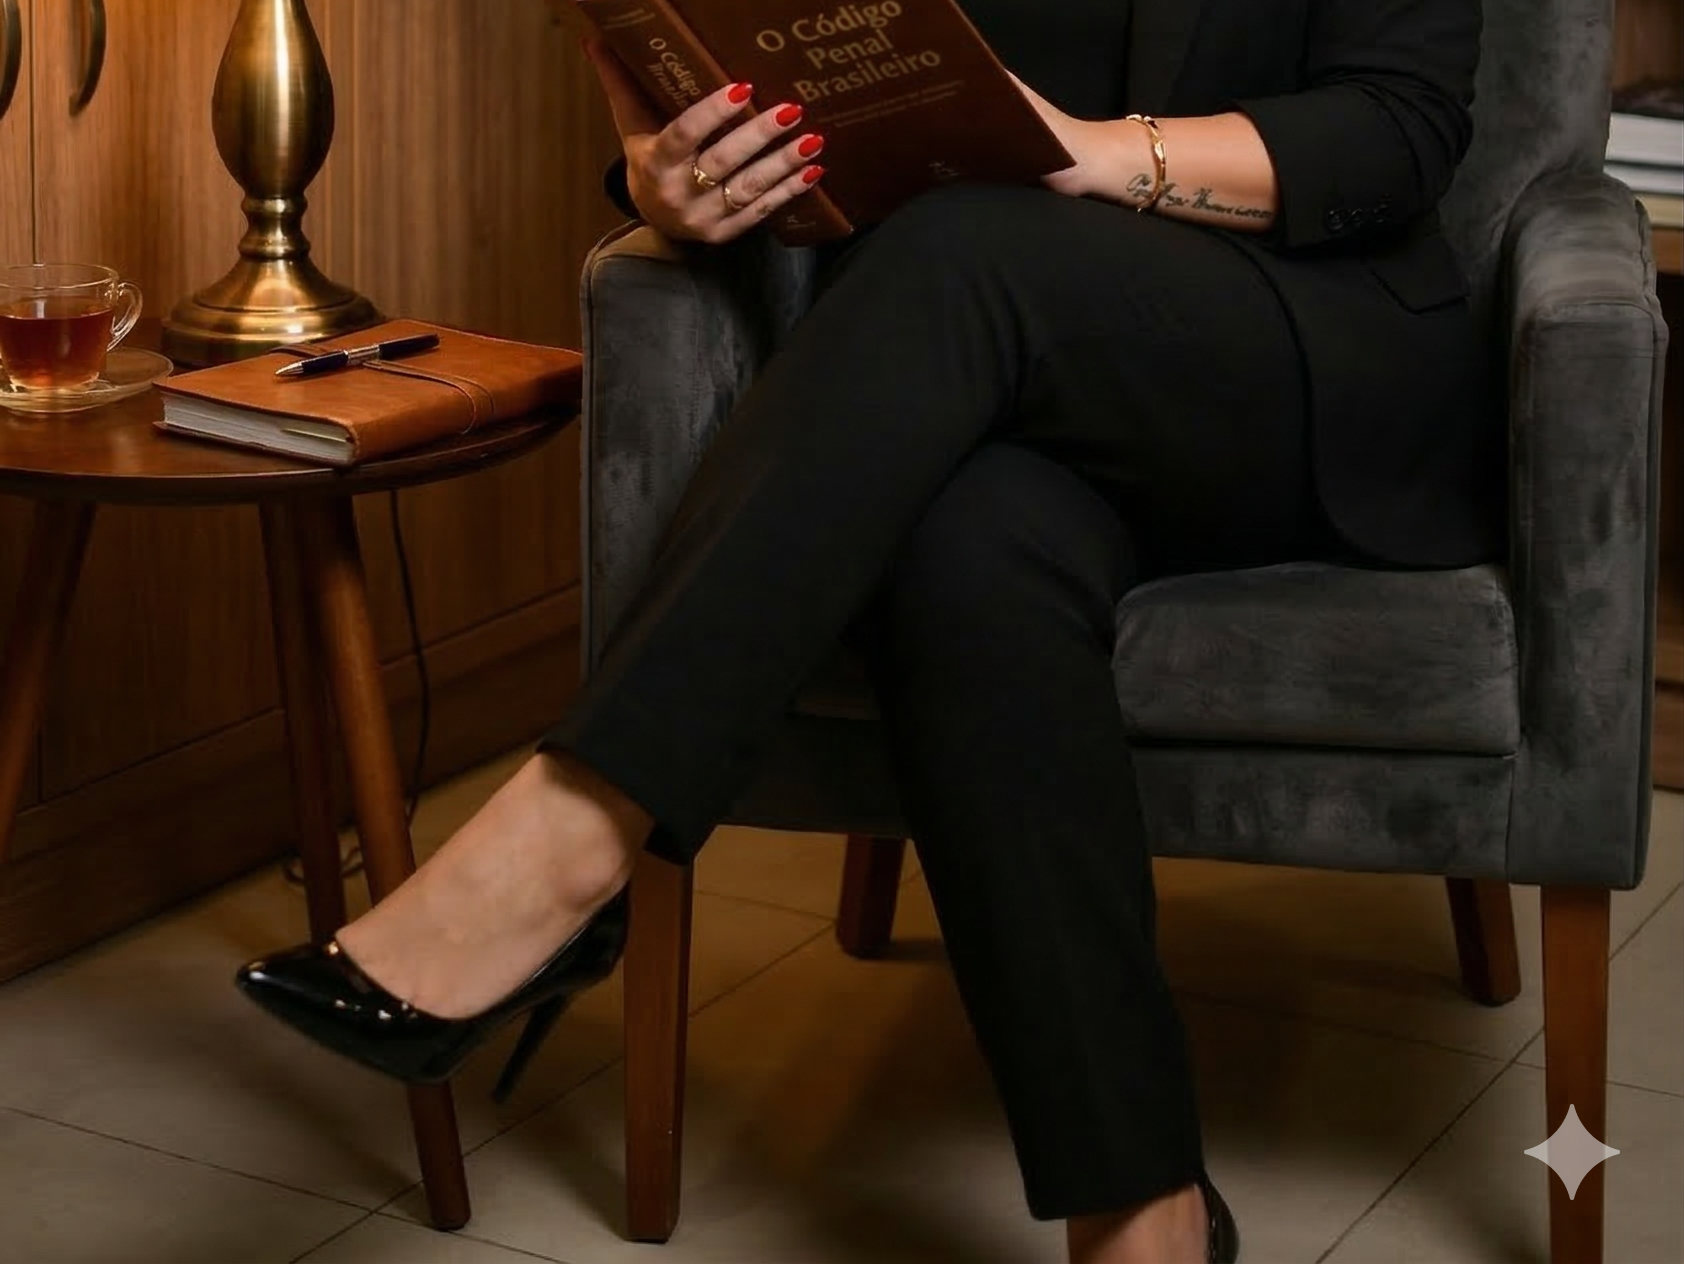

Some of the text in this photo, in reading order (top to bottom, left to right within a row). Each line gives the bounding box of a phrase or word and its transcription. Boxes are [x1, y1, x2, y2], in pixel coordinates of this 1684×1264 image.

[756, 0, 902, 52] O Código
[806, 29, 894, 70] Penal
[793, 50, 941, 103] Brasileiro
